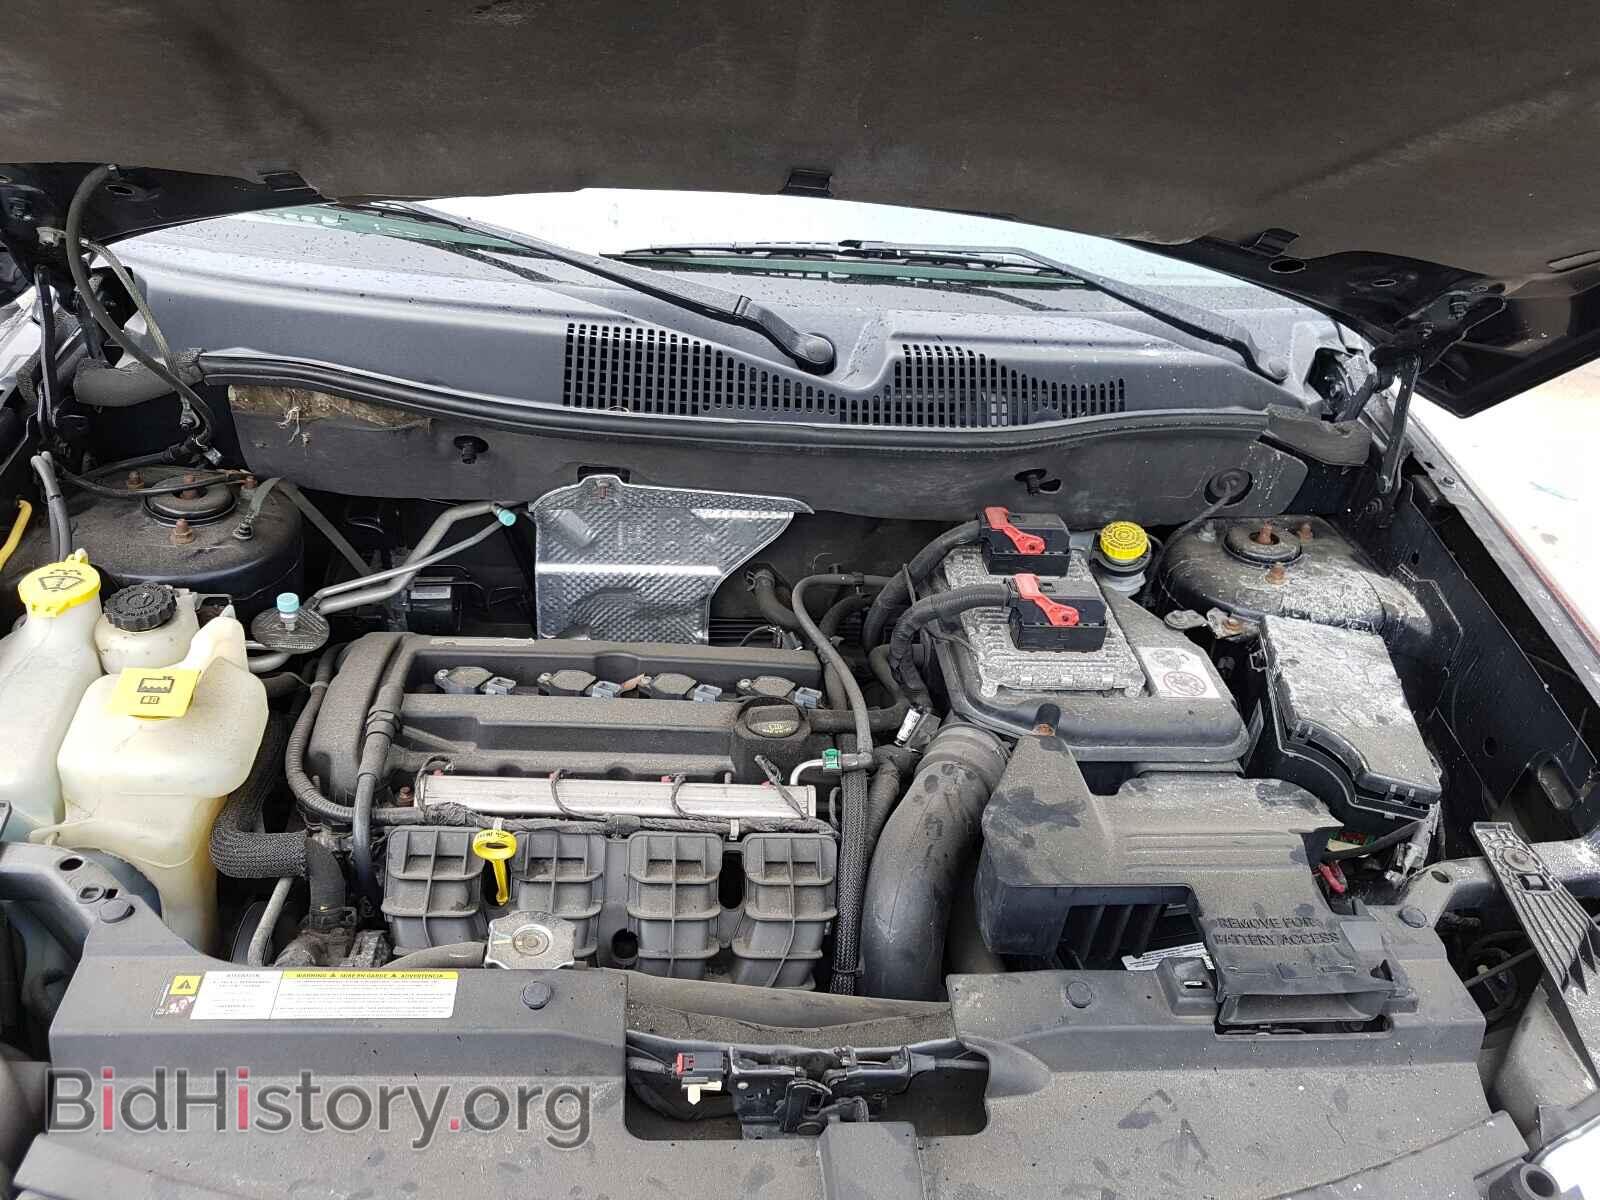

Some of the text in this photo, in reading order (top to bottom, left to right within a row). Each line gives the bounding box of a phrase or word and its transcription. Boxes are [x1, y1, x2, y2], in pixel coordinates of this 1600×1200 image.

[1216, 916, 1319, 929] REMOVE FOR
[1213, 932, 1340, 946] BATTERY ACCESS
